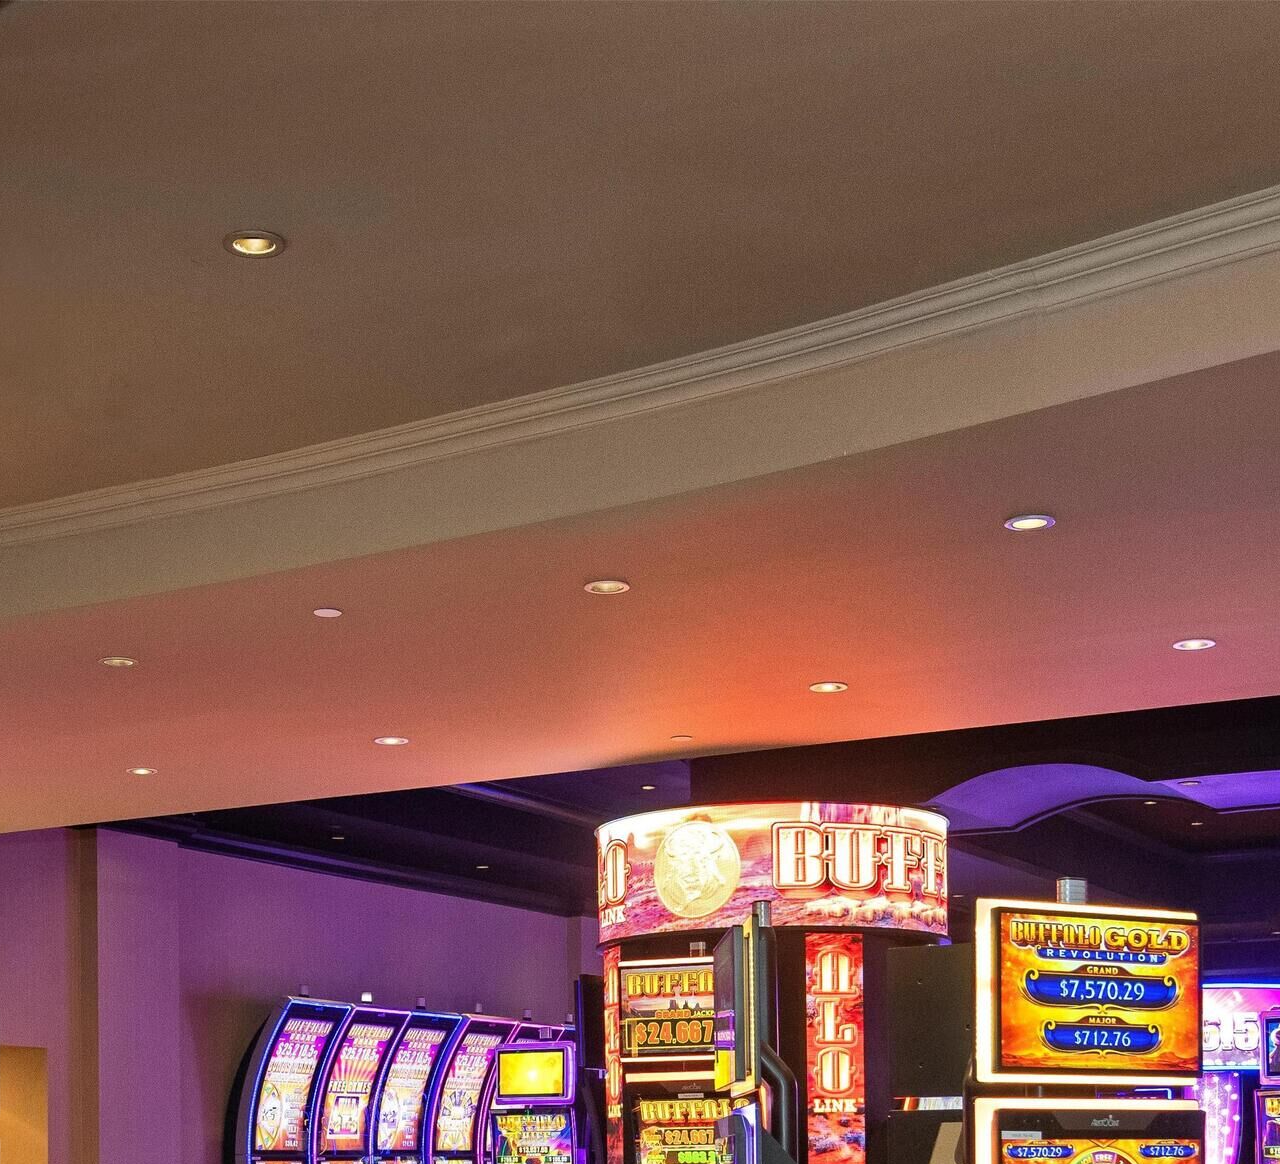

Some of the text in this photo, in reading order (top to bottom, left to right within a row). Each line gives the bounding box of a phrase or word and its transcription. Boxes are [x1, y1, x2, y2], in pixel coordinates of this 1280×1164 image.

[601, 905, 626, 928] LINK
[1011, 920, 1189, 955] BUFFALO GOLD
[1047, 950, 1158, 963] REVOLUTION
[1087, 966, 1119, 974] GRAND
[1060, 979, 1145, 1001] $7,570.29
[655, 1009, 691, 1019] GRAND
[1074, 1031, 1131, 1047] $712.76
[328, 1081, 347, 1094] FREE
[813, 1099, 858, 1113] LINK
[1017, 1146, 1184, 1157] $7,570.29 $712.76
[1095, 1153, 1113, 1162] FREE
